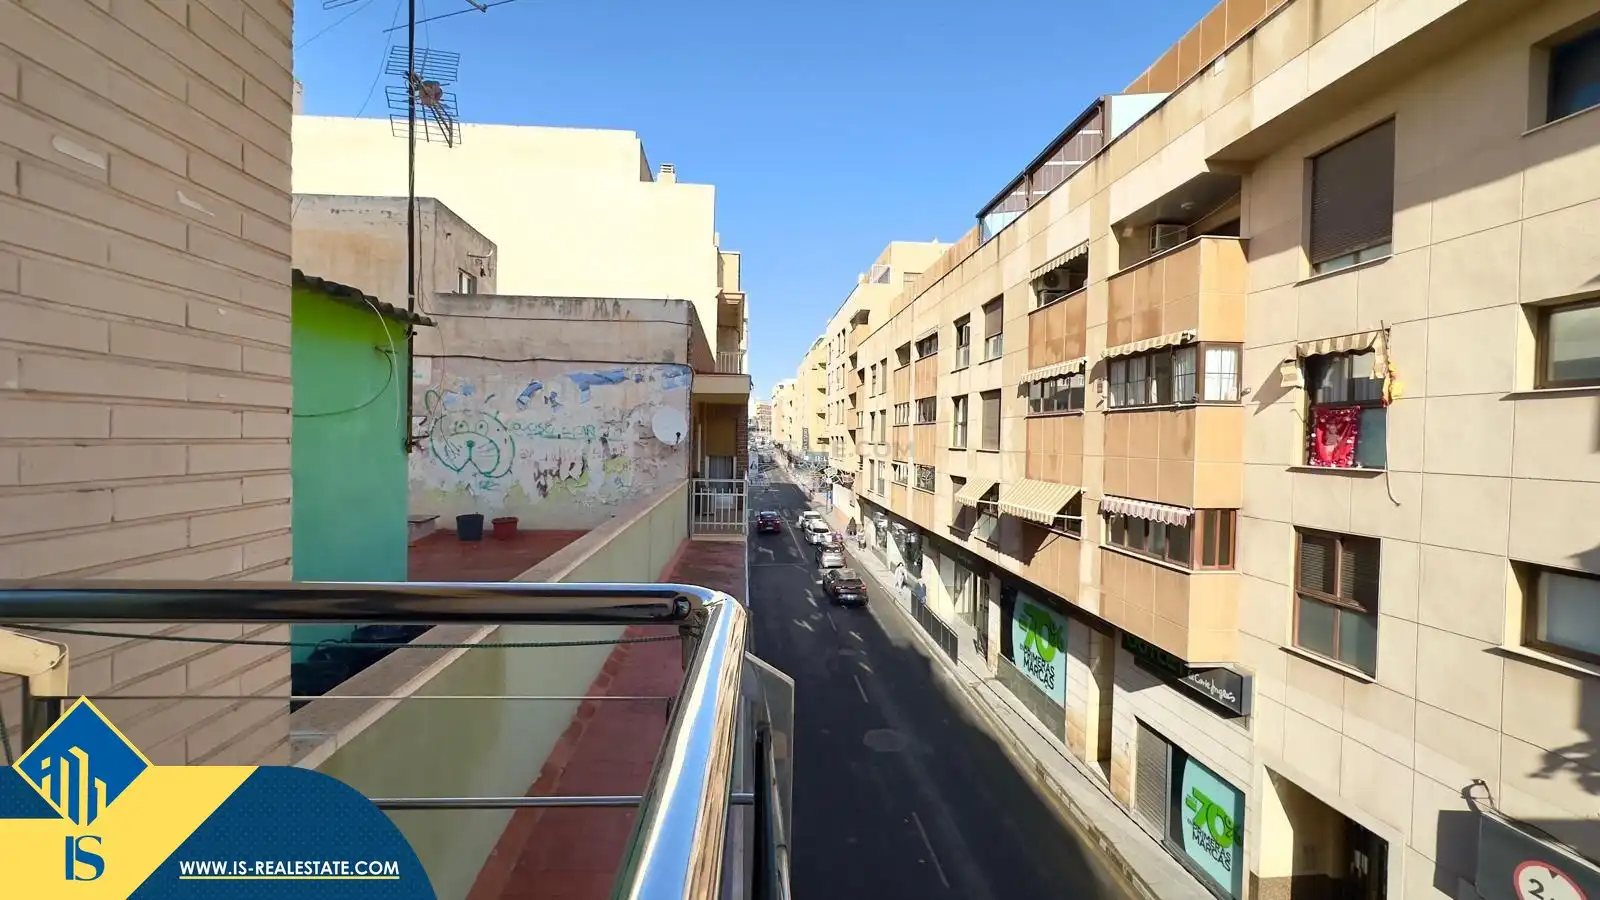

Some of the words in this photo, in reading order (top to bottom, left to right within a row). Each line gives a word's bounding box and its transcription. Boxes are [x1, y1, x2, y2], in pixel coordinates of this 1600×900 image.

[1023, 645, 1055, 681] PRIMERAS
[1023, 656, 1055, 690] MARCAS
[1192, 822, 1232, 866] PRIMERAS
[1192, 829, 1231, 872] MARCAS
